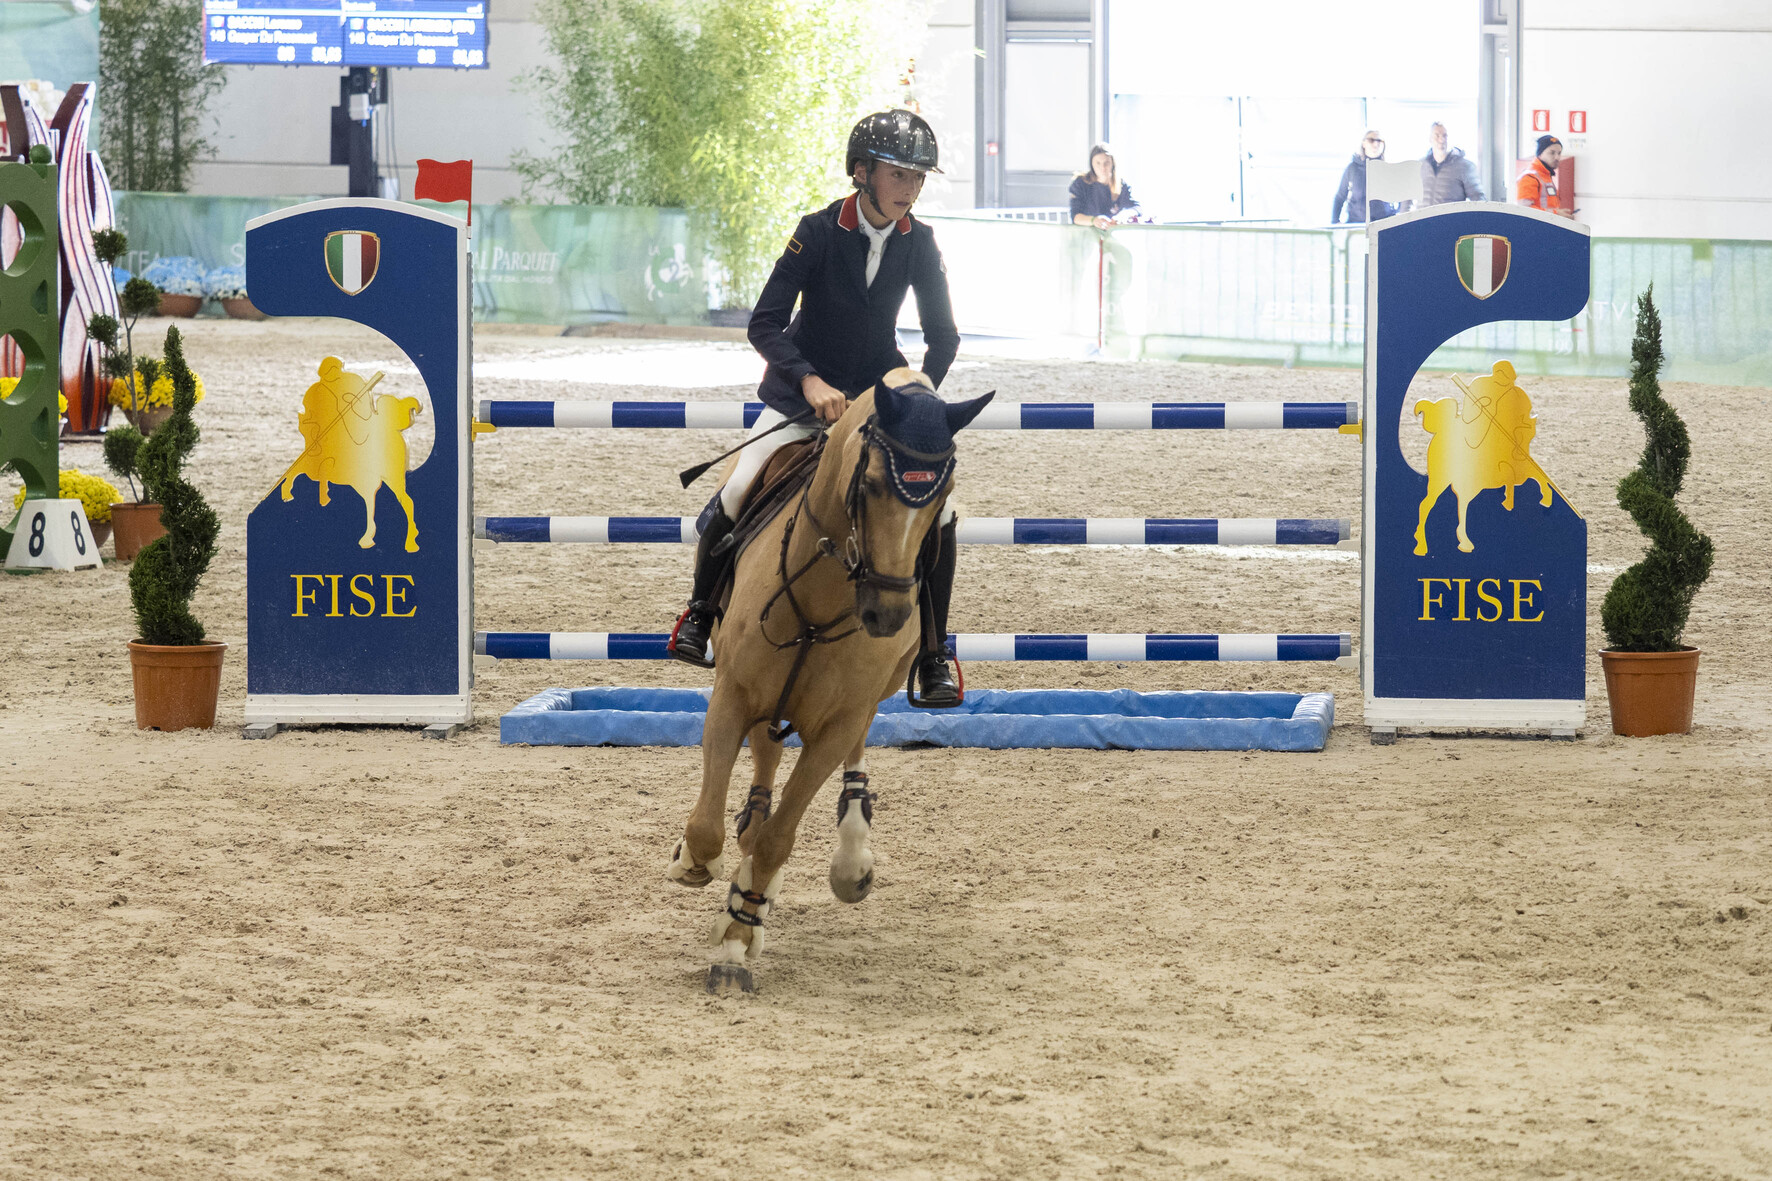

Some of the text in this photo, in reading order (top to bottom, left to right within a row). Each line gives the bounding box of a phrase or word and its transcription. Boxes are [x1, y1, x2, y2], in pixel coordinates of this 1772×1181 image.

[29, 511, 46, 558] 8
[70, 510, 86, 556] 8
[290, 574, 417, 617] FISE
[1417, 578, 1545, 622] FISE
